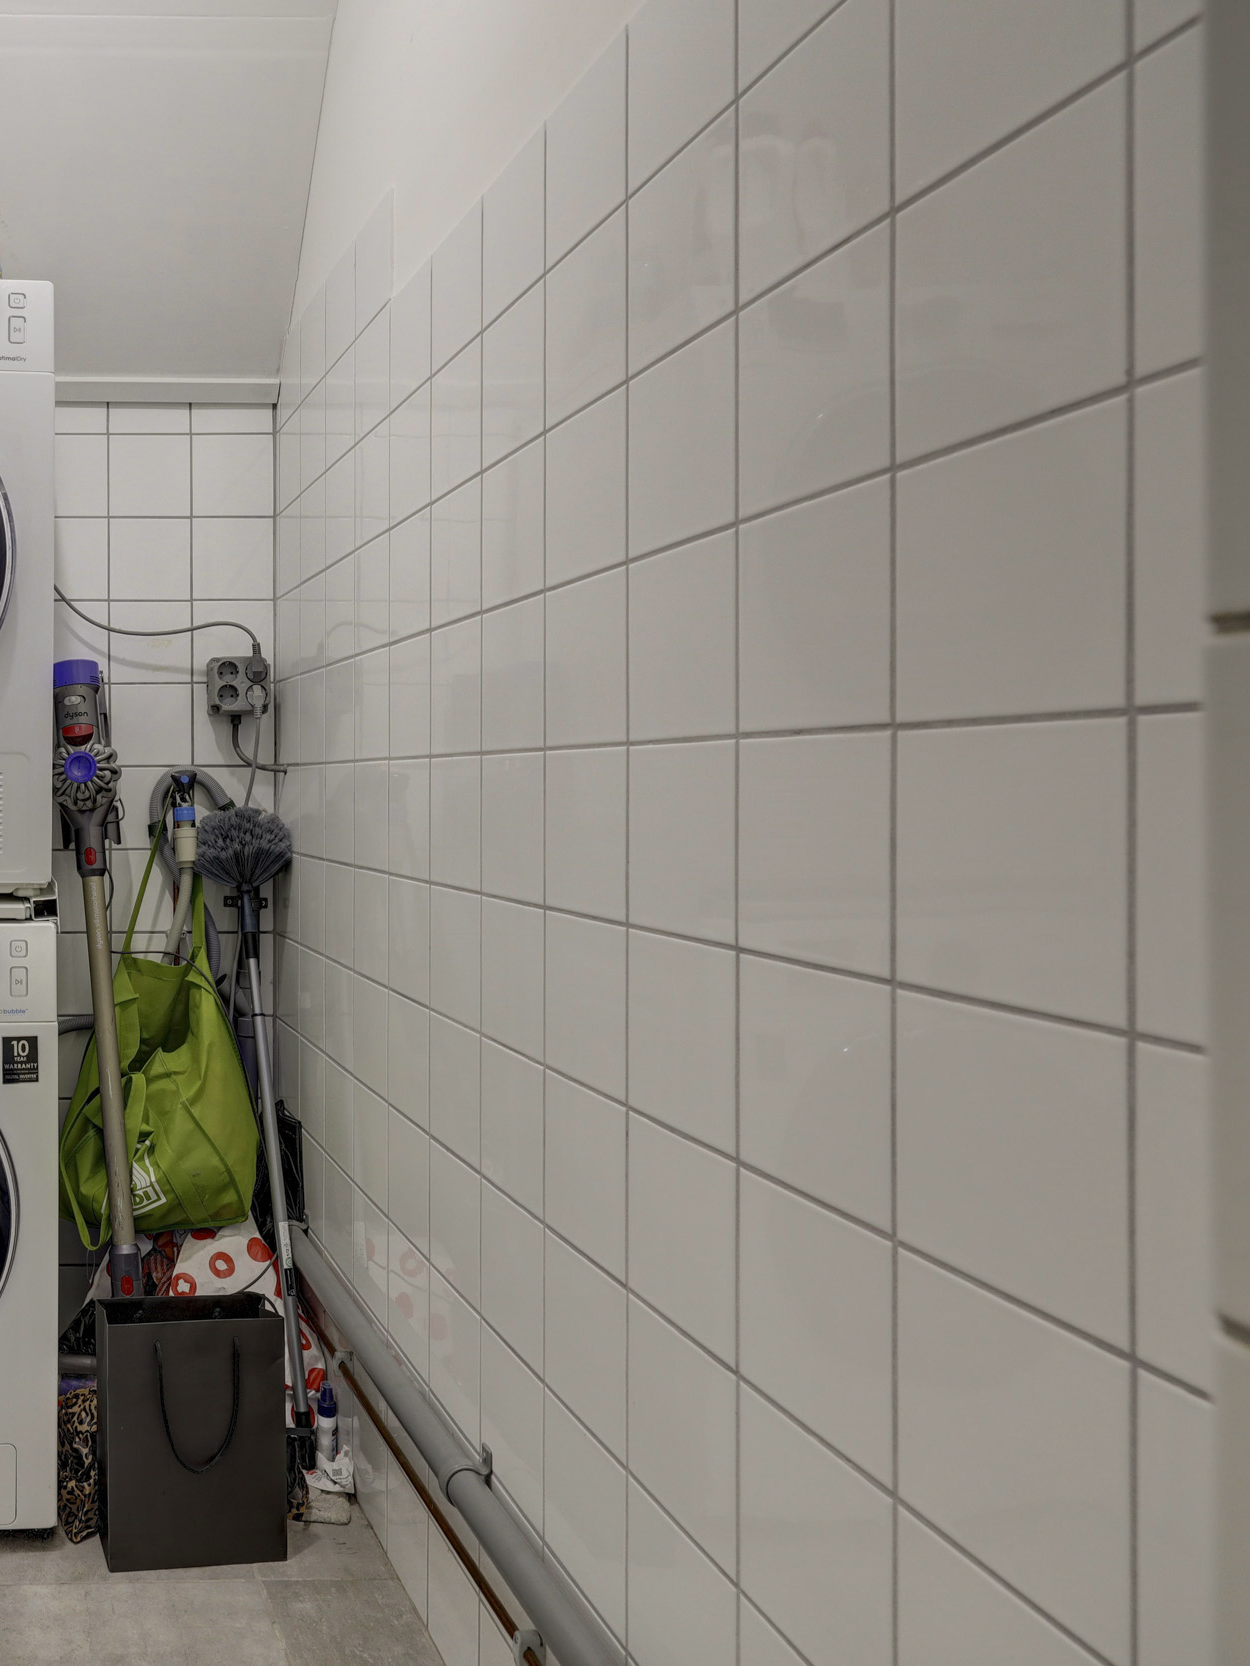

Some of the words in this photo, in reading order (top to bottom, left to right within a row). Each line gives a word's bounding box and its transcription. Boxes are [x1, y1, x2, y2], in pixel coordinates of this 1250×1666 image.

[64, 711, 89, 720] dyson
[11, 1040, 30, 1056] 10
[3, 1062, 38, 1070] WARRANTY
